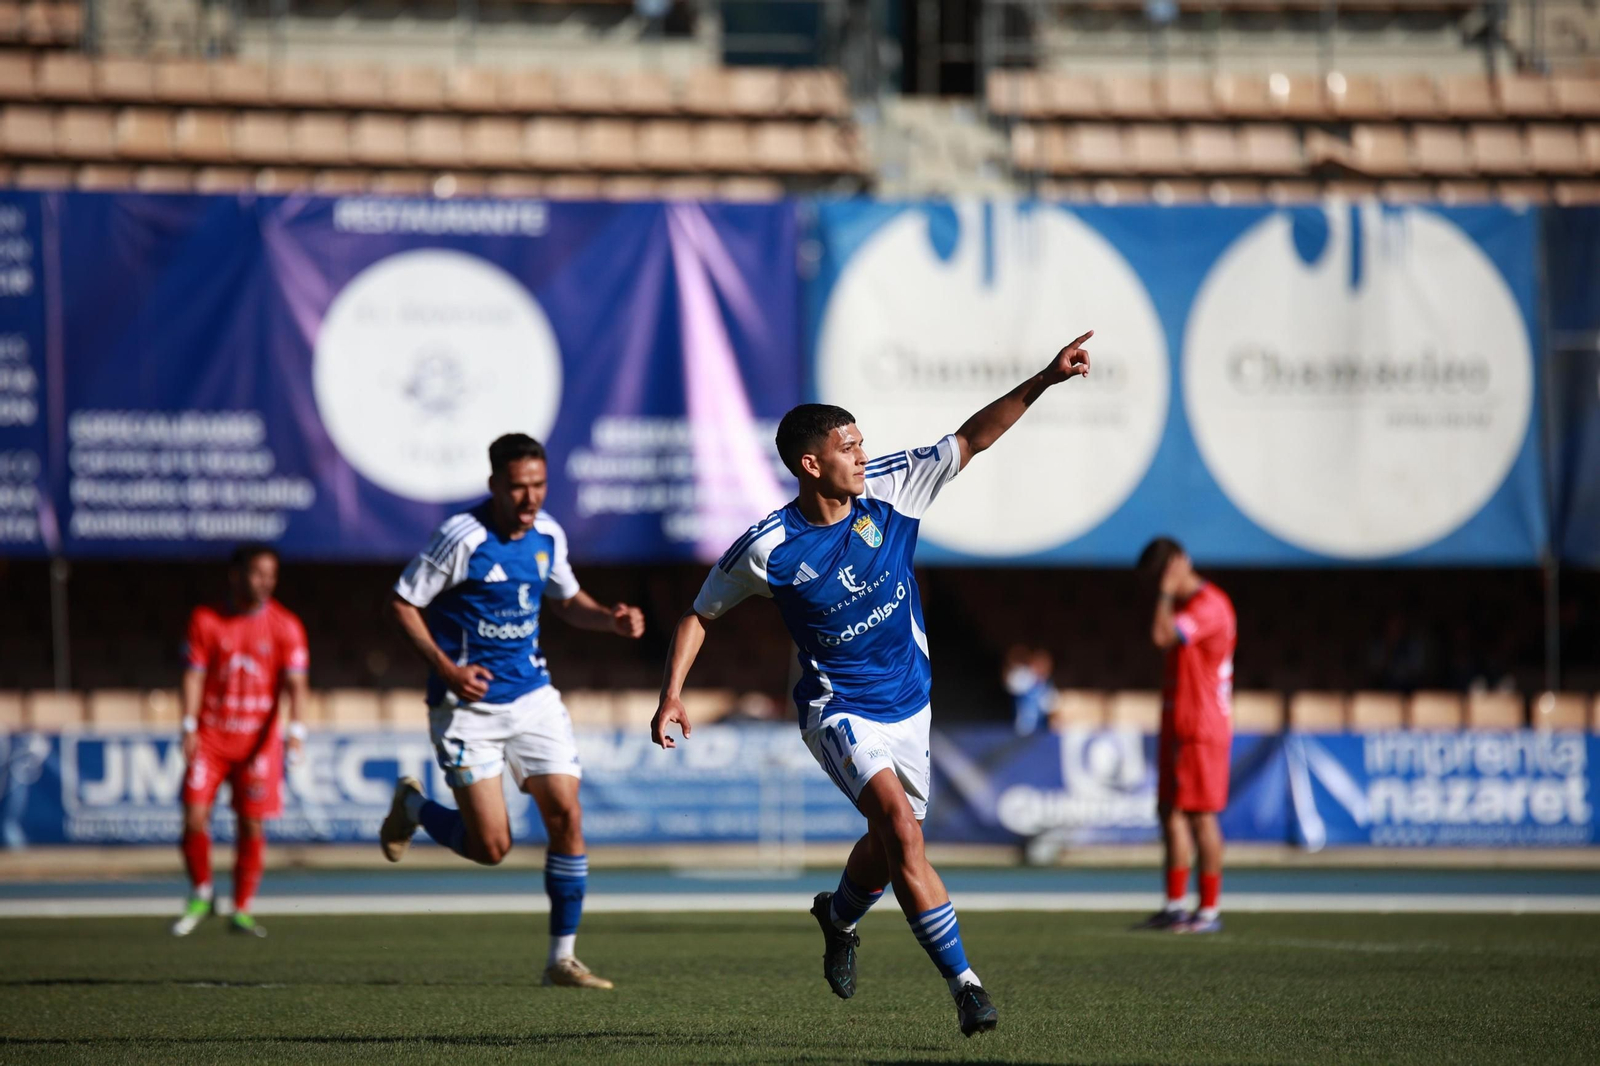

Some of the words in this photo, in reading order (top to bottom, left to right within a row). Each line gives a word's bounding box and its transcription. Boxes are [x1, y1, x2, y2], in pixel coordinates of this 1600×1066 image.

[822, 570, 891, 616] LAFLAMENCA
[823, 717, 857, 758] 11
[1369, 778, 1590, 824] nazaret
